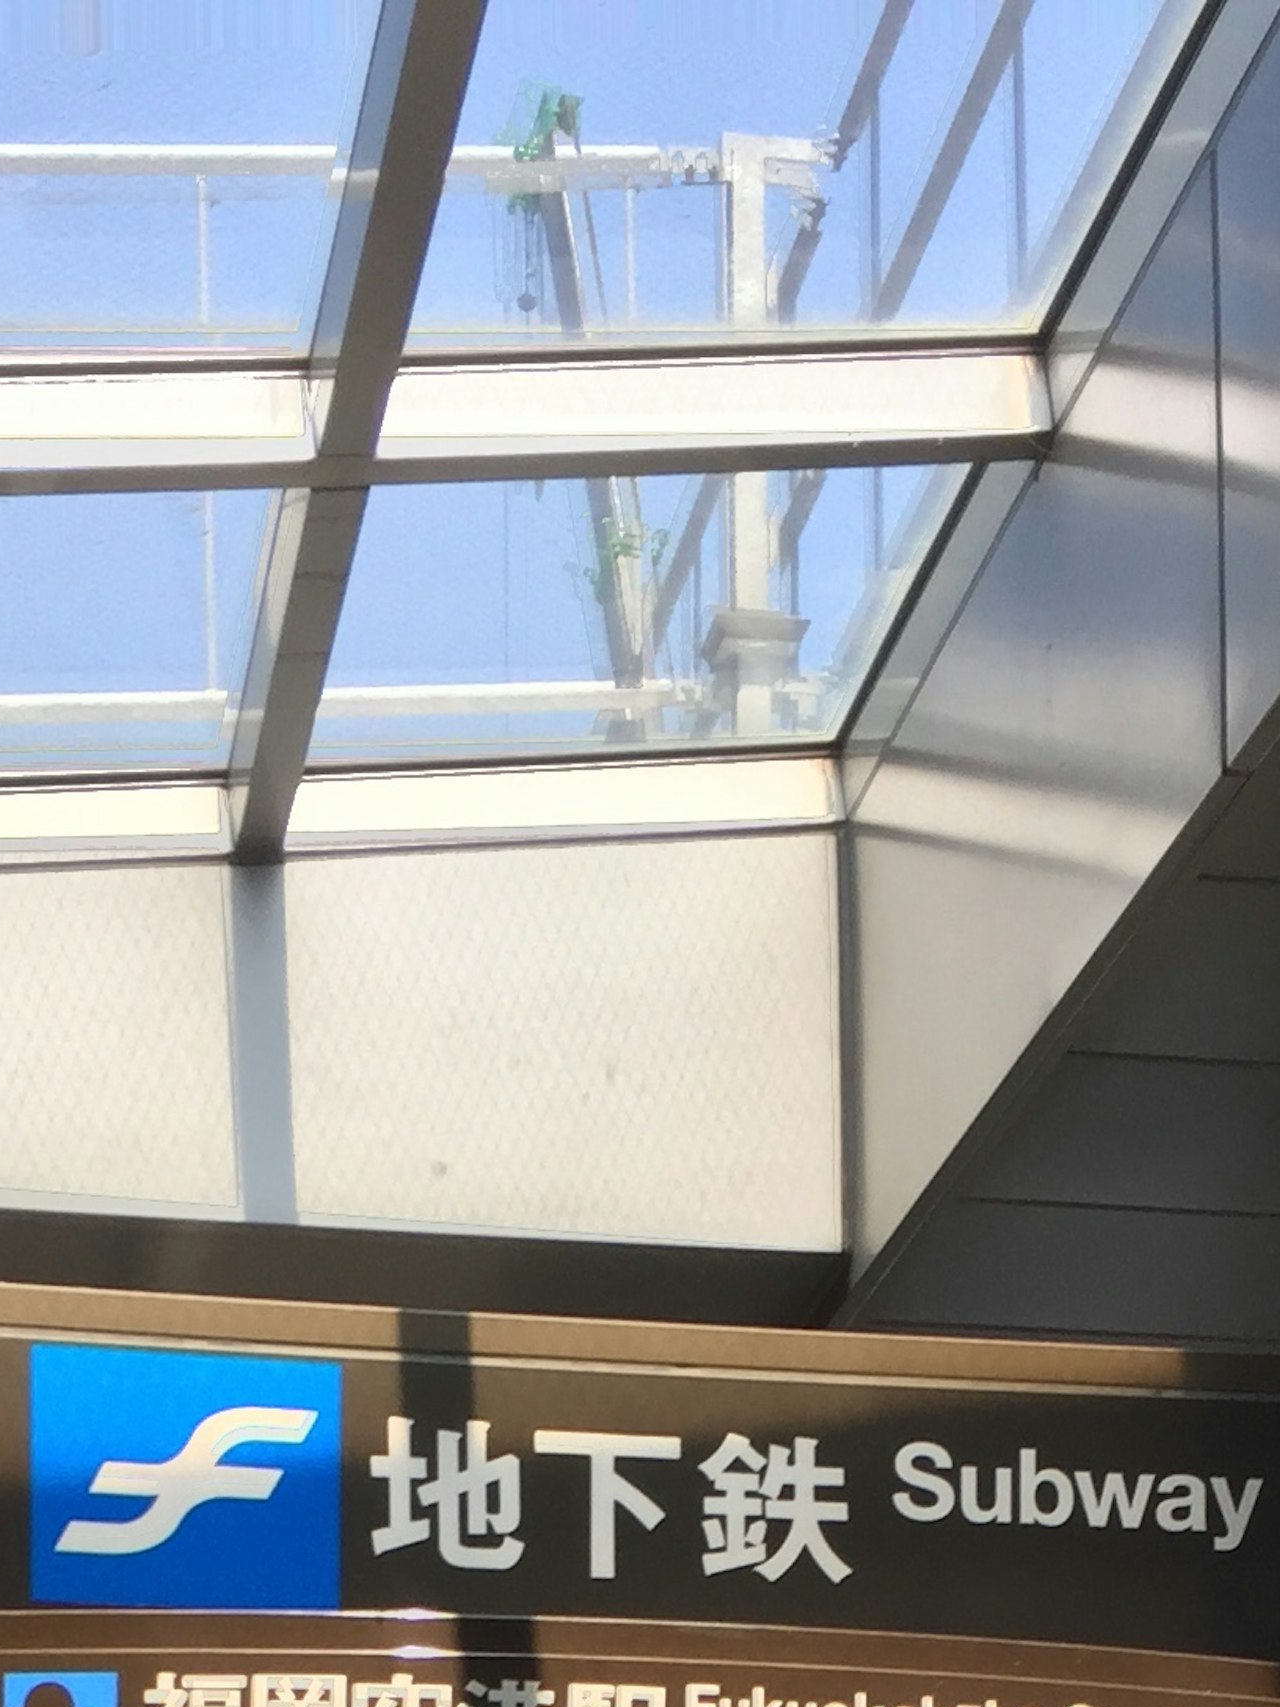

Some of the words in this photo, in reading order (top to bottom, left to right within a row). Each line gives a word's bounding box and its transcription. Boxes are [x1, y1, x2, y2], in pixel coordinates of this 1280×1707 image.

[369, 1416, 852, 1585] 地下鉄
[891, 1440, 1263, 1552] Subway
